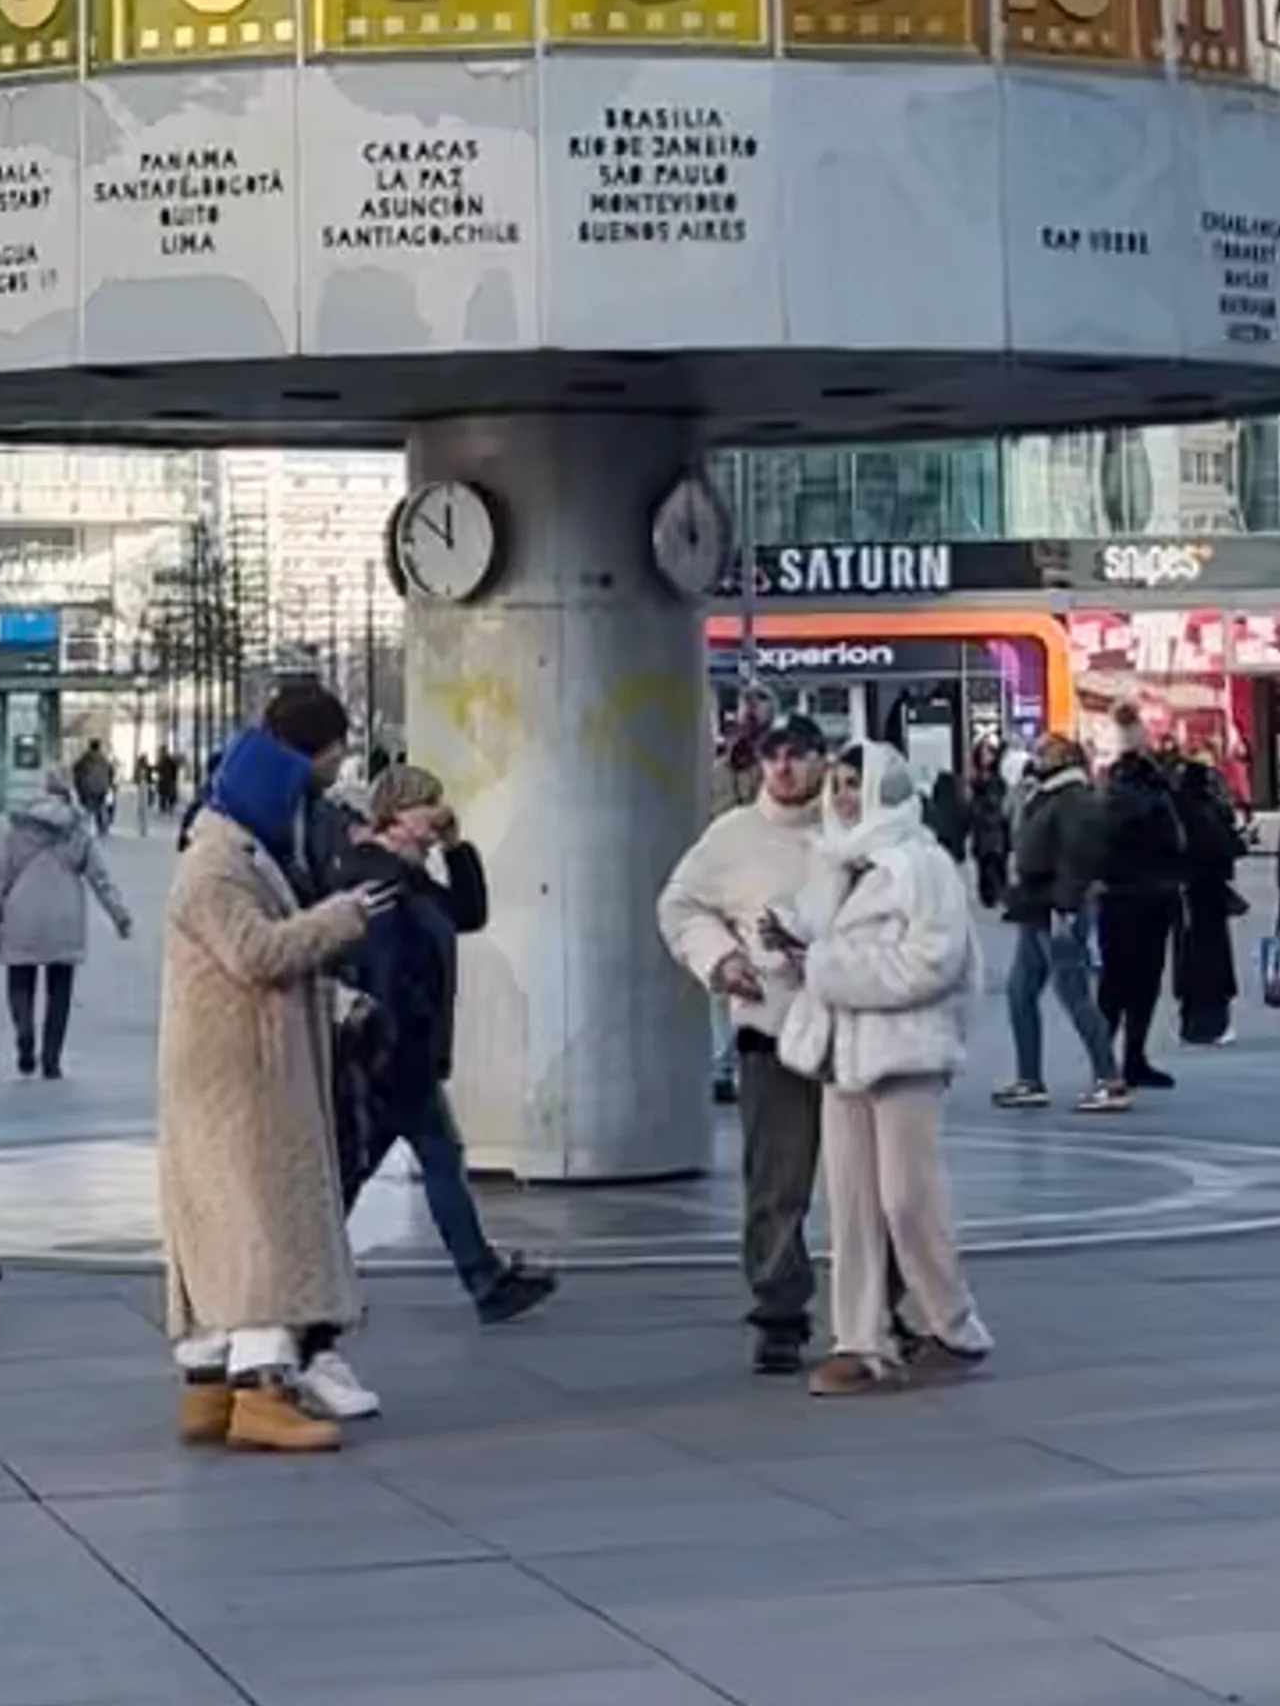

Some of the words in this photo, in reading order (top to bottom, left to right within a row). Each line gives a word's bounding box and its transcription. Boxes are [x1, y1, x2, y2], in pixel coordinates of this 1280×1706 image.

[362, 139, 479, 164] CARACAS
[569, 136, 606, 158] RIO
[614, 136, 642, 157] DE
[652, 135, 758, 159] JANEIRO
[140, 149, 238, 173] PANAMA
[376, 169, 408, 191] LA
[419, 166, 462, 189] PAZ
[654, 163, 728, 186] PAULO
[159, 204, 219, 227] QUITO
[590, 192, 738, 215] MONTEVIDEO
[578, 221, 669, 243] BUENOS
[676, 218, 746, 242] AIRES
[161, 233, 215, 256] LIMA
[779, 546, 950, 592] SATURN
[1103, 543, 1200, 586] snipes
